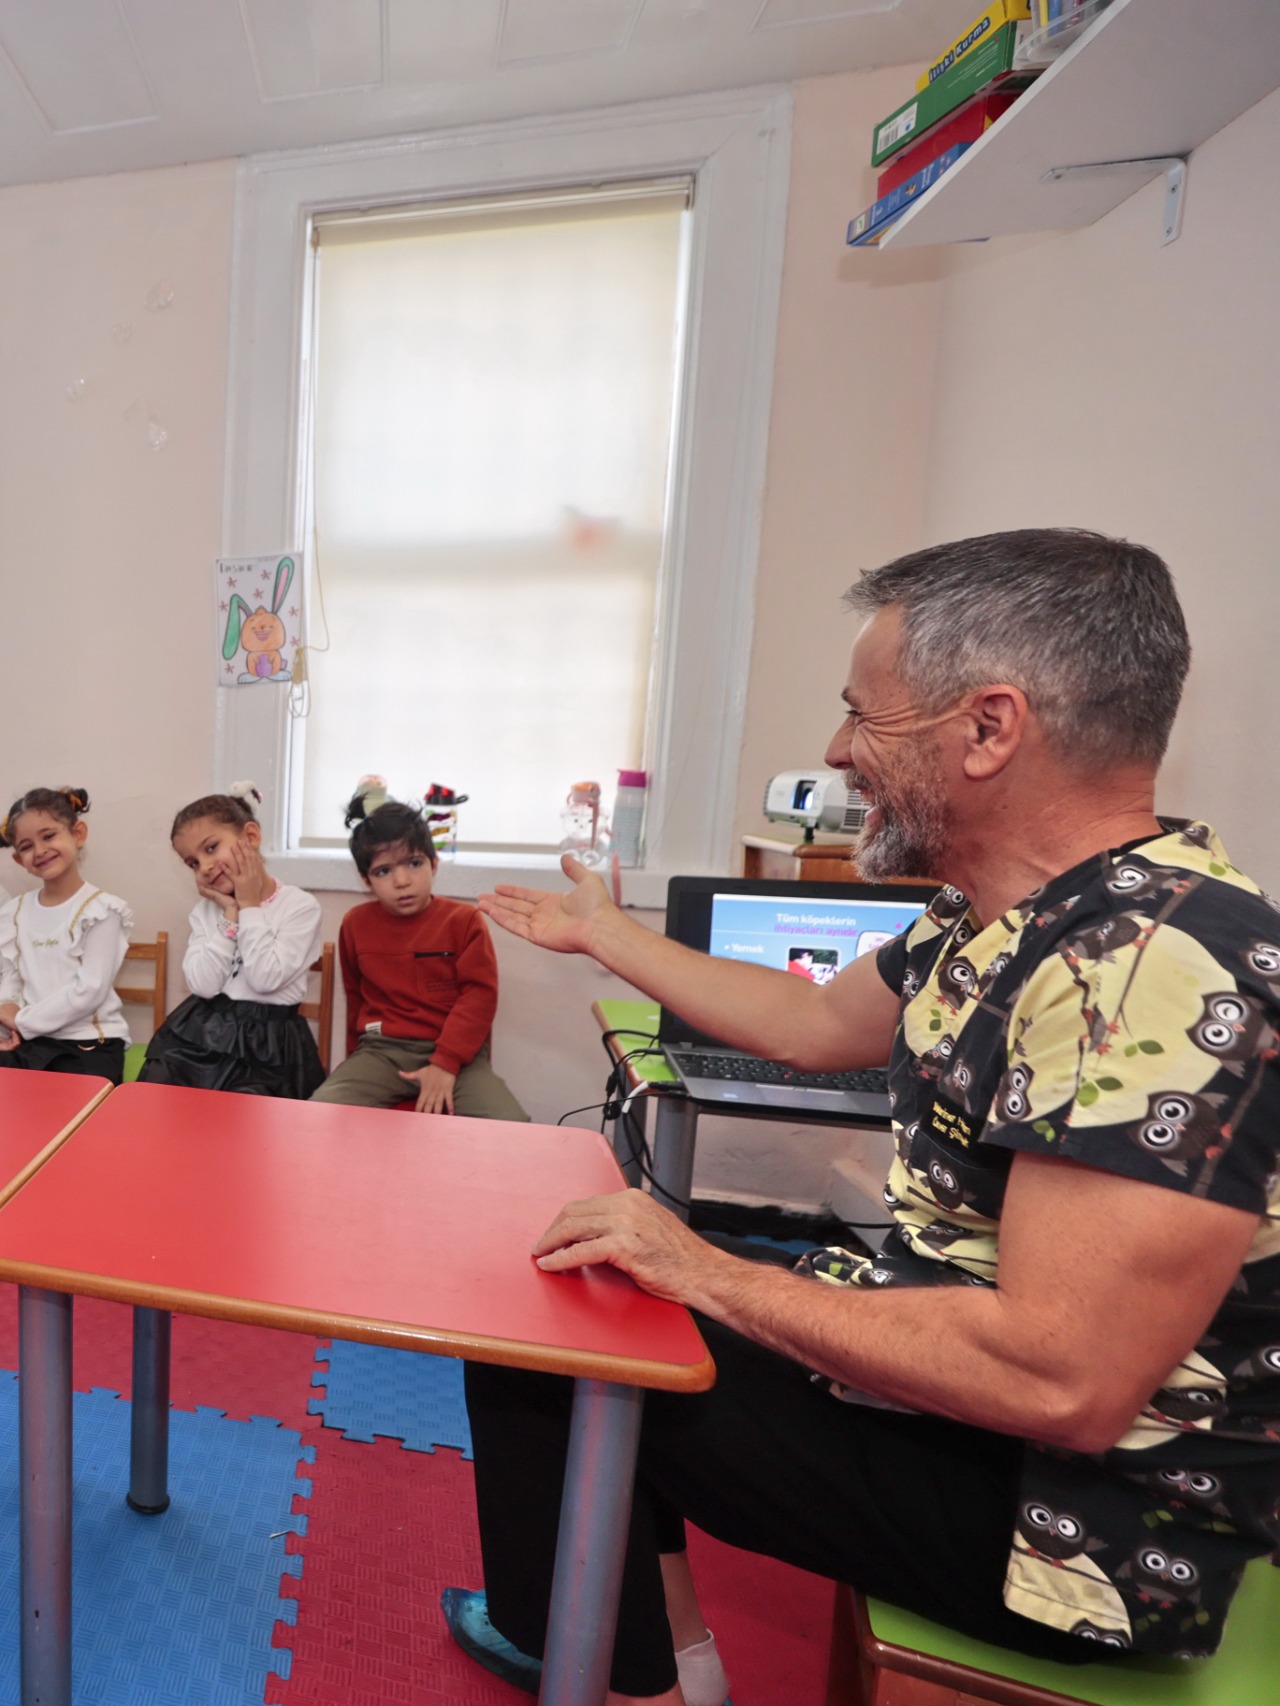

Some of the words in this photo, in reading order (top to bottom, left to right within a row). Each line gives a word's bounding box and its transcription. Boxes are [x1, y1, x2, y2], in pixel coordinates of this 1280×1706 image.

[955, 17, 990, 57] Kurma
[776, 913, 799, 923] Tüm
[801, 914, 856, 926] köpeklerin
[731, 943, 764, 953] Yemek
